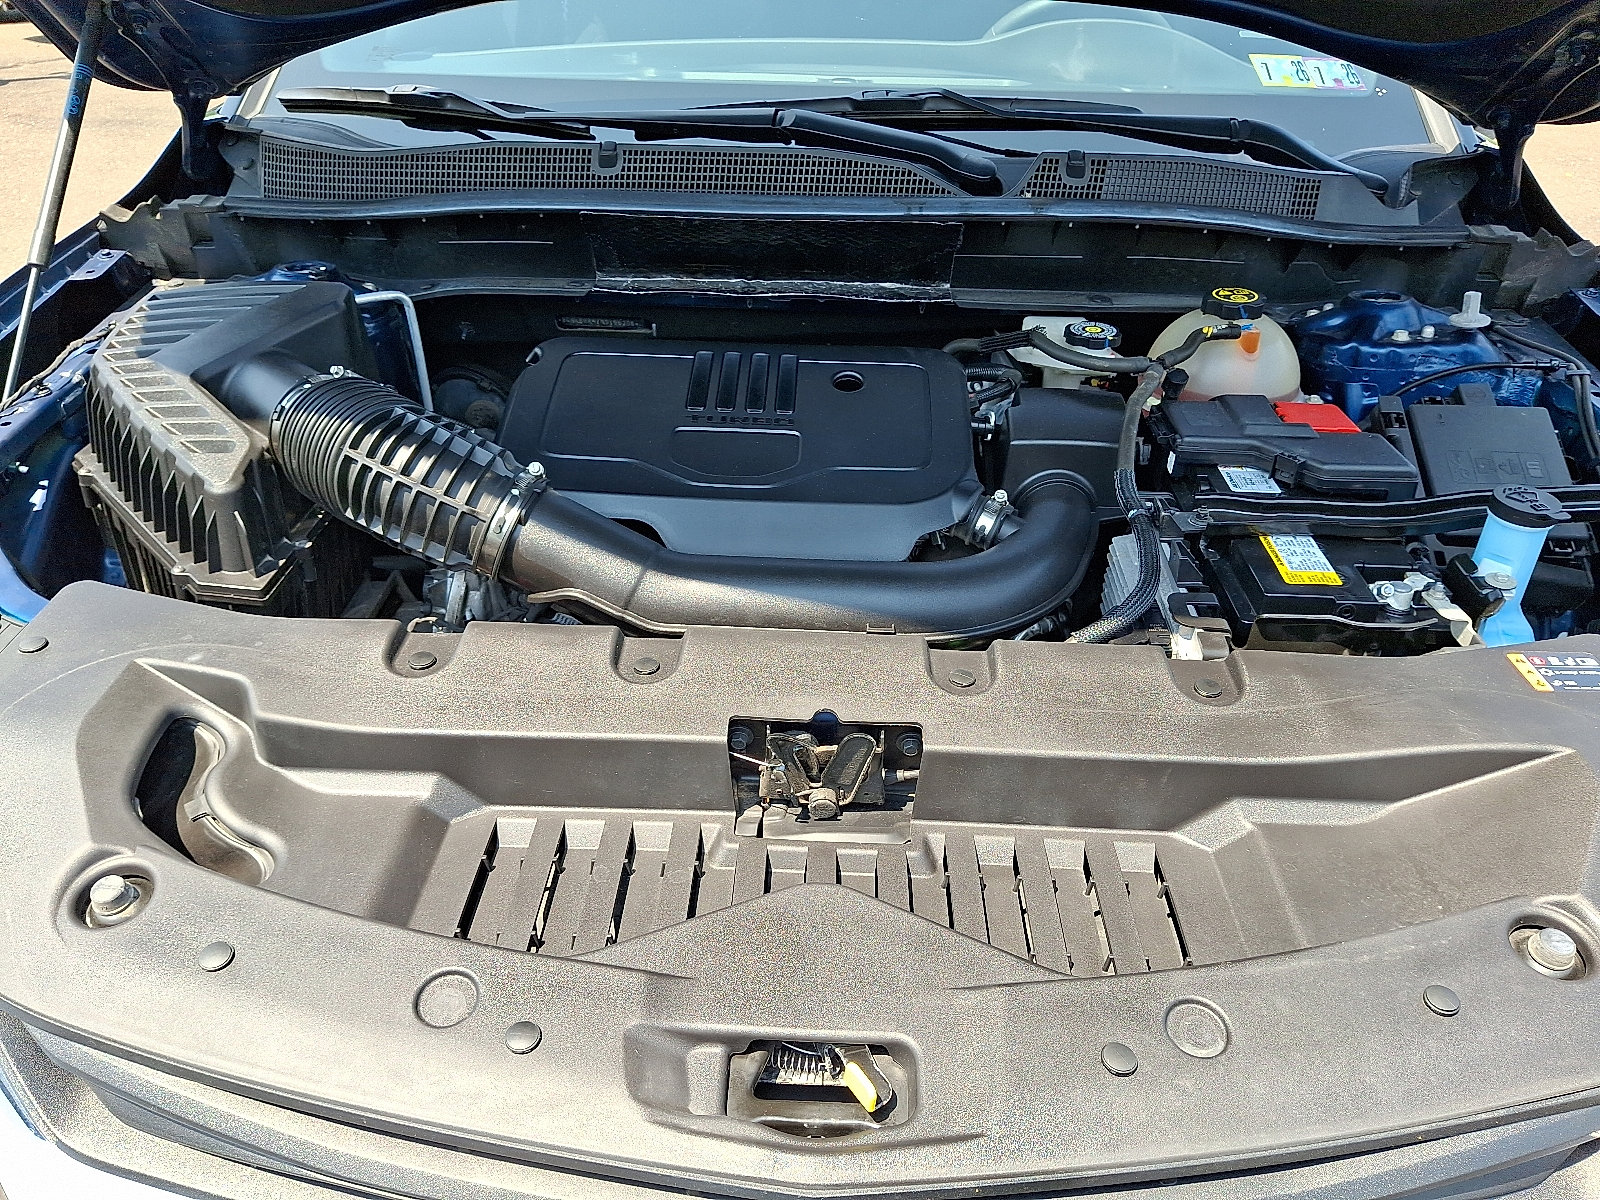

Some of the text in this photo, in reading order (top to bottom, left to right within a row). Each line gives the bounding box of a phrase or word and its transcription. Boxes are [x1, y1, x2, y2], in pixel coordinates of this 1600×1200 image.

[1260, 60, 1311, 82] 7 26
[1313, 63, 1361, 85] 7 26
